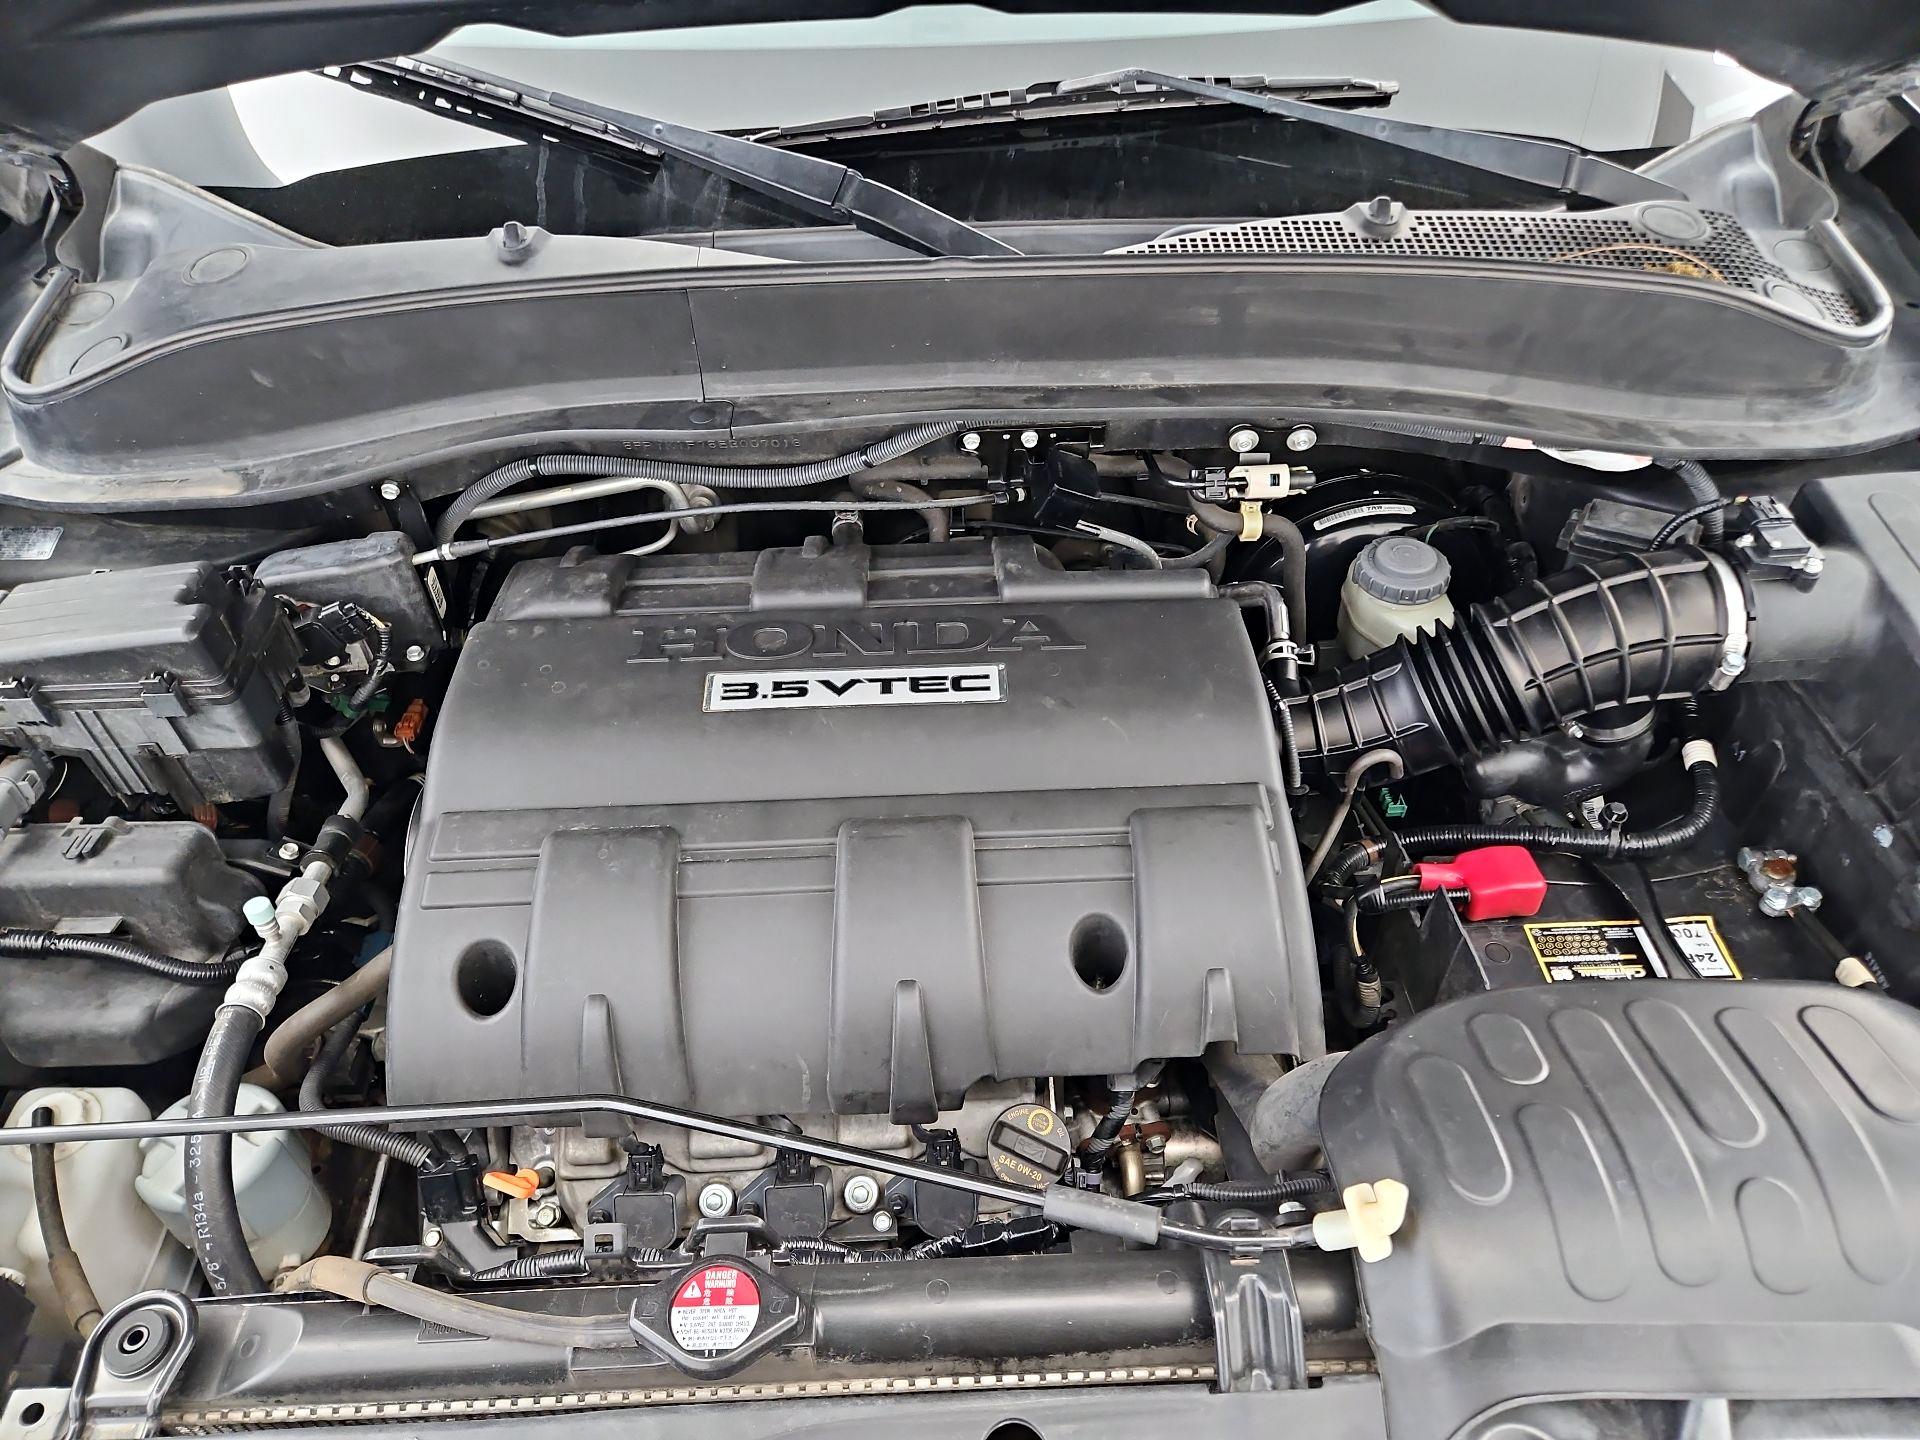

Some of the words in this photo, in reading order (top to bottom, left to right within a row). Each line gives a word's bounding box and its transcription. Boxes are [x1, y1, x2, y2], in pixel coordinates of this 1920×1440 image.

[627, 613, 1087, 664] HONDA
[720, 679, 810, 701] 3.5
[816, 674, 991, 698] VTEC
[1007, 1108, 1030, 1120] ENGINE
[1057, 1127, 1065, 1139] OIL
[998, 1154, 1017, 1169] SAE
[1017, 1163, 1043, 1182] 0W-20
[192, 1190, 211, 1240] R134a
[705, 1270, 738, 1280] DANGER
